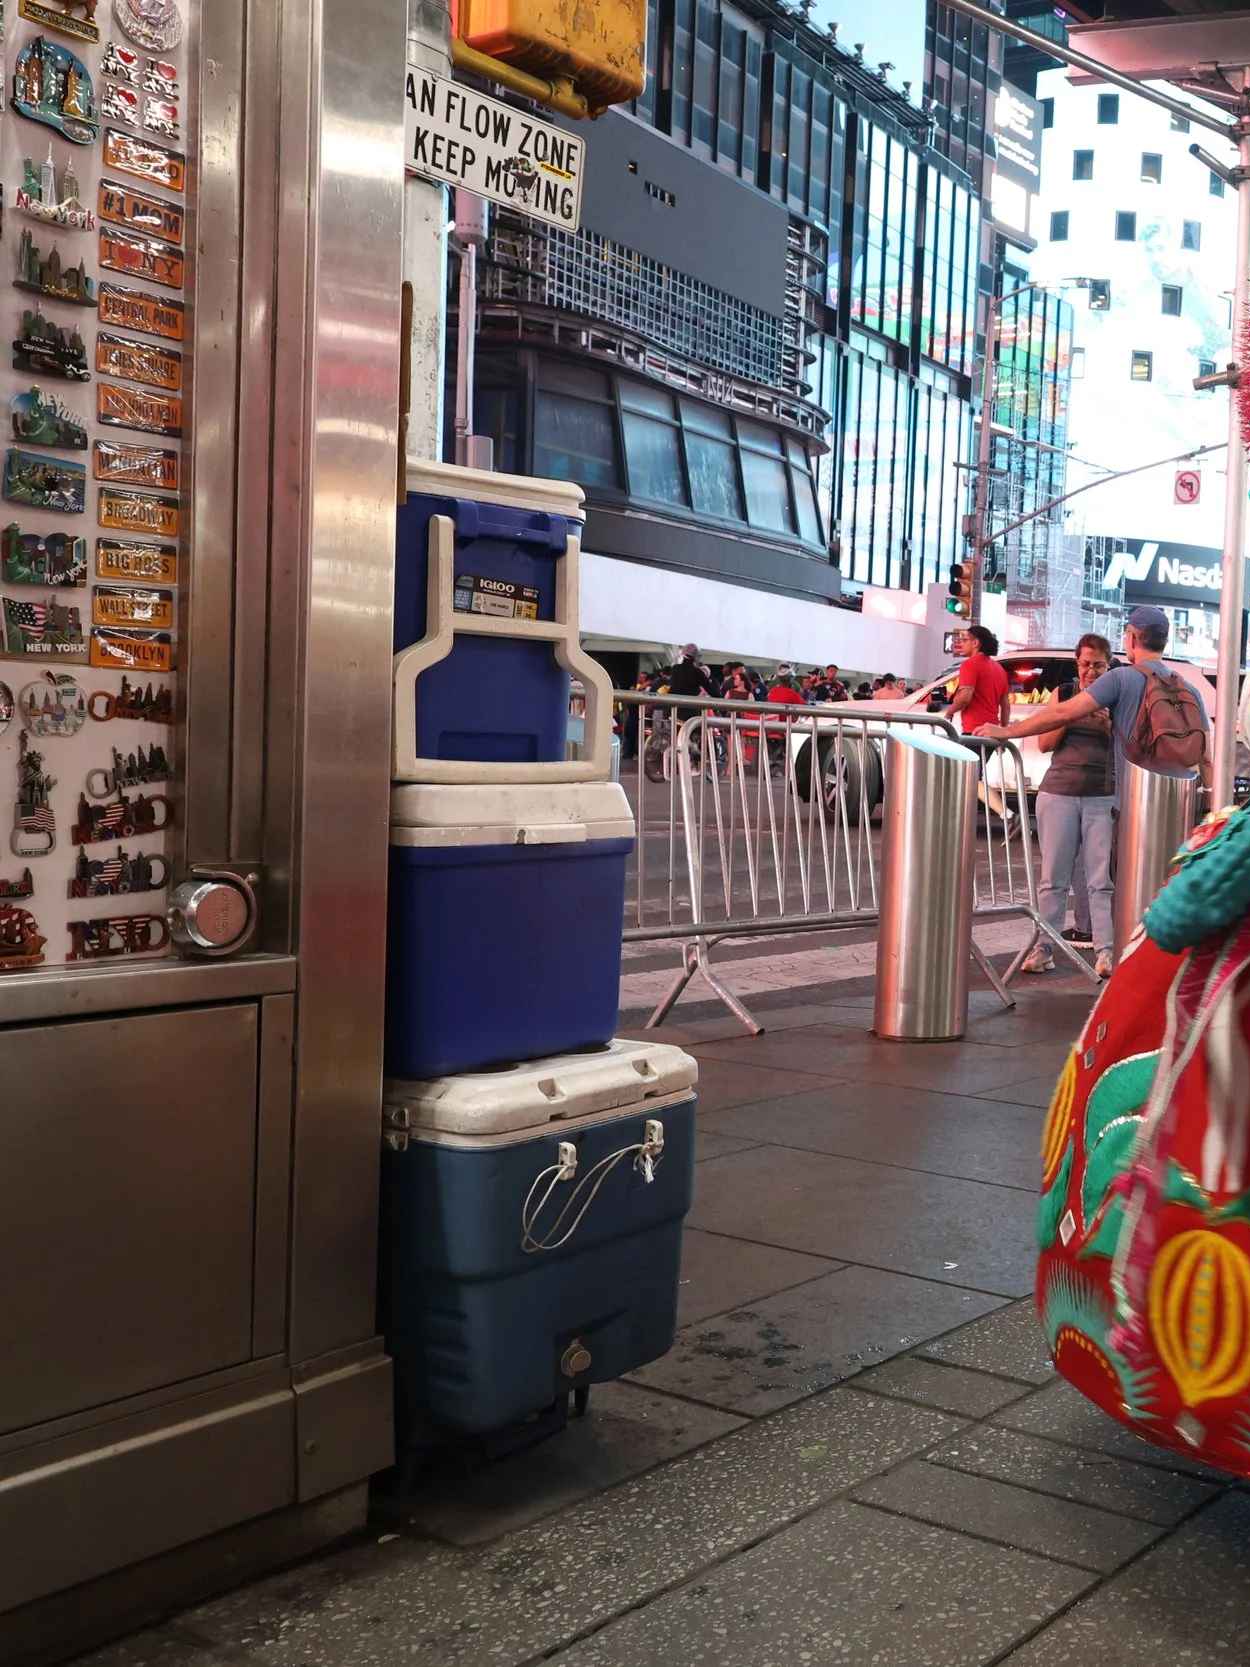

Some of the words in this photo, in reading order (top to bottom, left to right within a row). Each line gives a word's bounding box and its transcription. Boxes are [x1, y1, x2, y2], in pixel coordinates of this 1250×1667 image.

[445, 89, 511, 148] FLOW
[518, 121, 578, 177] ZONE
[413, 126, 476, 179] KEEP
[484, 155, 574, 220] MOING
[103, 191, 127, 219] #1
[132, 201, 180, 235] MOM
[140, 250, 180, 278] NY
[104, 295, 149, 322] CENTRAL
[153, 307, 179, 330] PARK
[43, 495, 65, 508] New
[106, 501, 174, 526] BROADWAY
[106, 552, 131, 570] BIG
[480, 578, 515, 593] IGLOO
[101, 599, 128, 615] WALL
[26, 643, 52, 653] NEW
[56, 643, 87, 653] YORK
[101, 642, 165, 661] BROOKLYN
